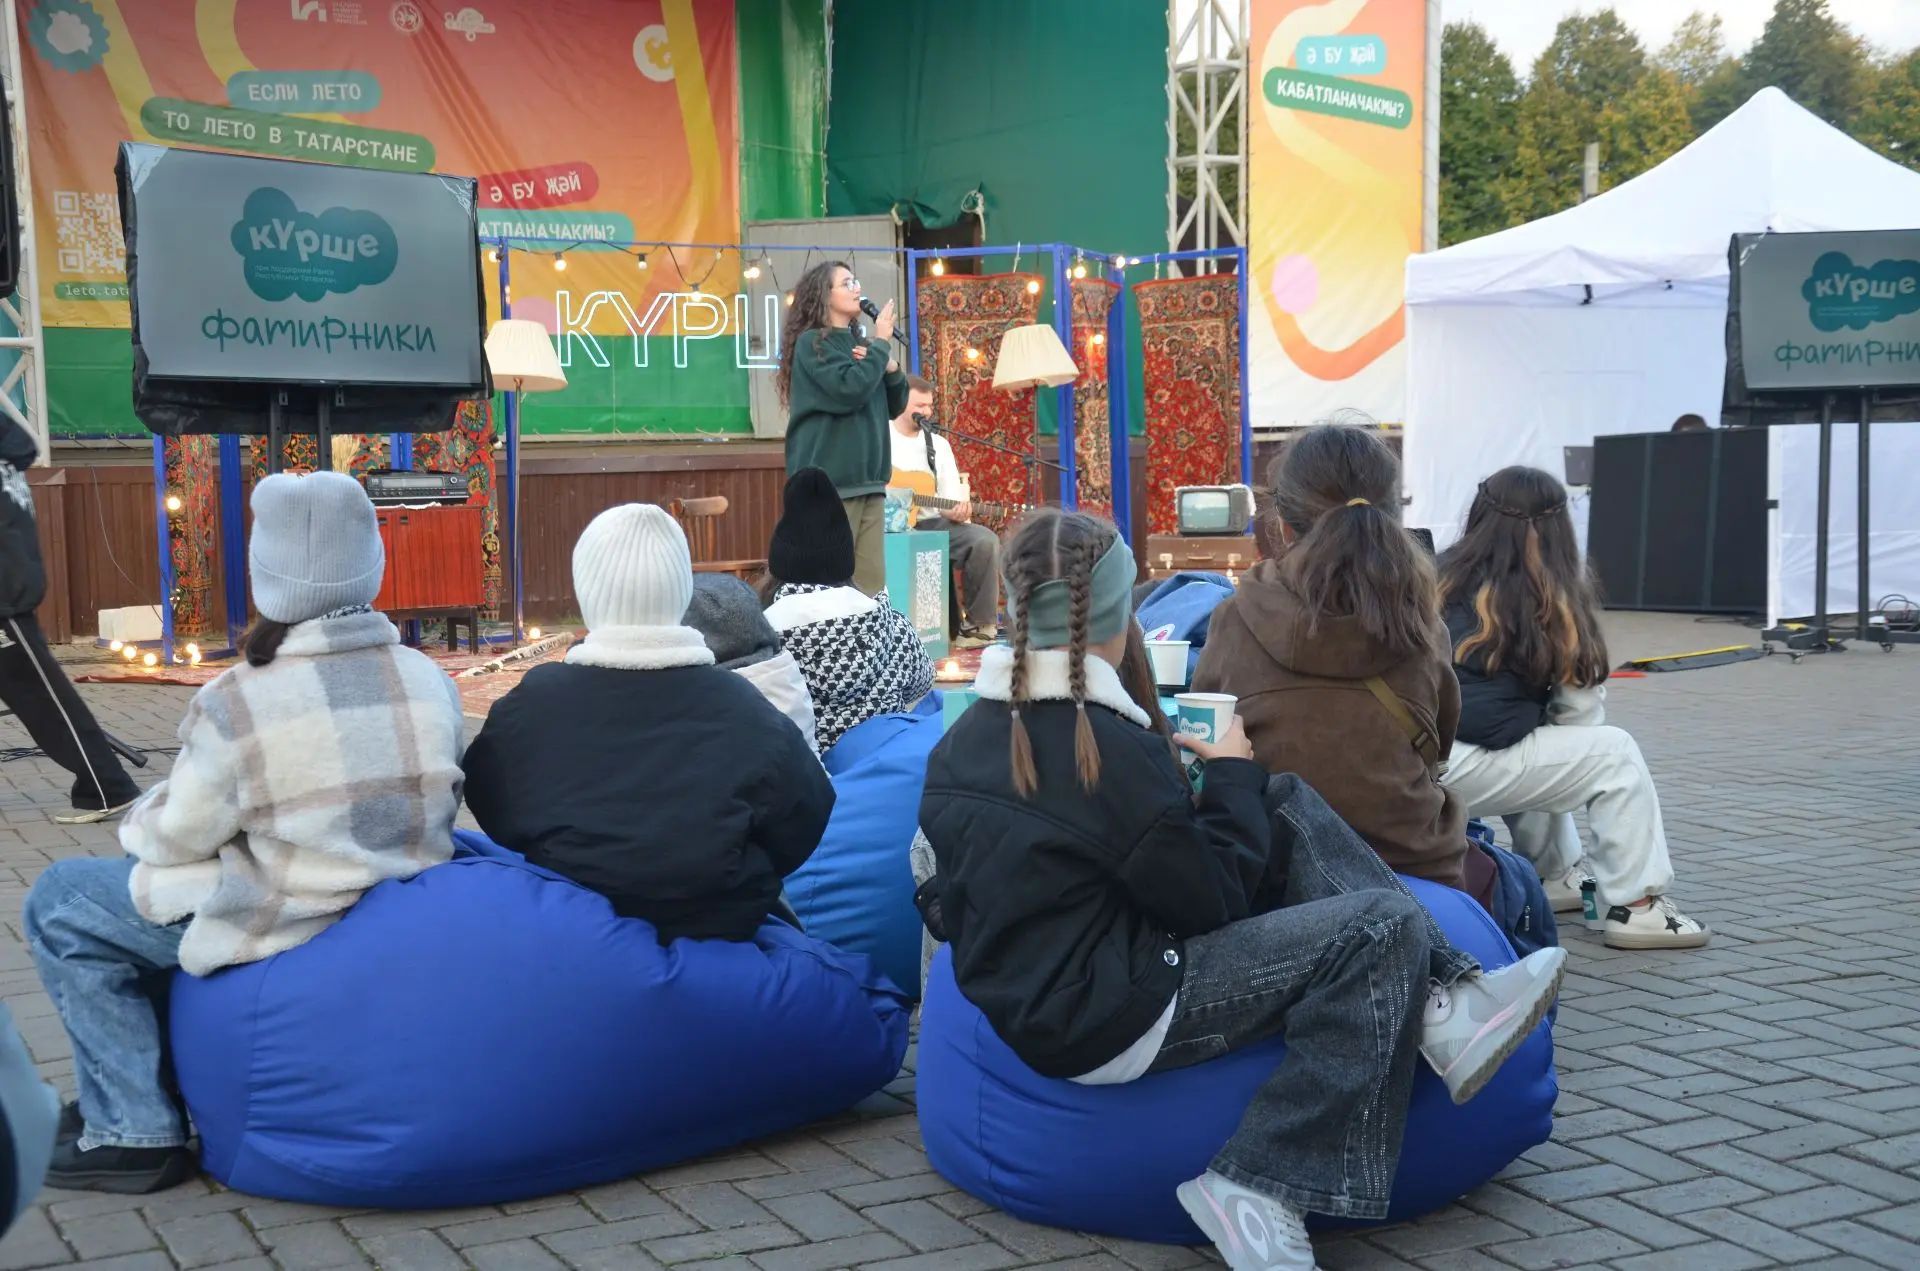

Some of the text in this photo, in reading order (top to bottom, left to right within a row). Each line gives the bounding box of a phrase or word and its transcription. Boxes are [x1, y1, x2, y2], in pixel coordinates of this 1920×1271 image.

[1306, 47, 1317, 64] Ә
[1324, 46, 1342, 64] БУ
[247, 83, 362, 102] ЕСЛИ ЛЕТО
[1276, 78, 1405, 119] КАБАТЛАНАЧАКМЫ?
[163, 110, 418, 164] ТО ЛЕТО В ТАТАРСТАНЕ
[512, 180, 535, 201] БУ
[478, 220, 616, 241] АТЛАНАЧАКМЫ?
